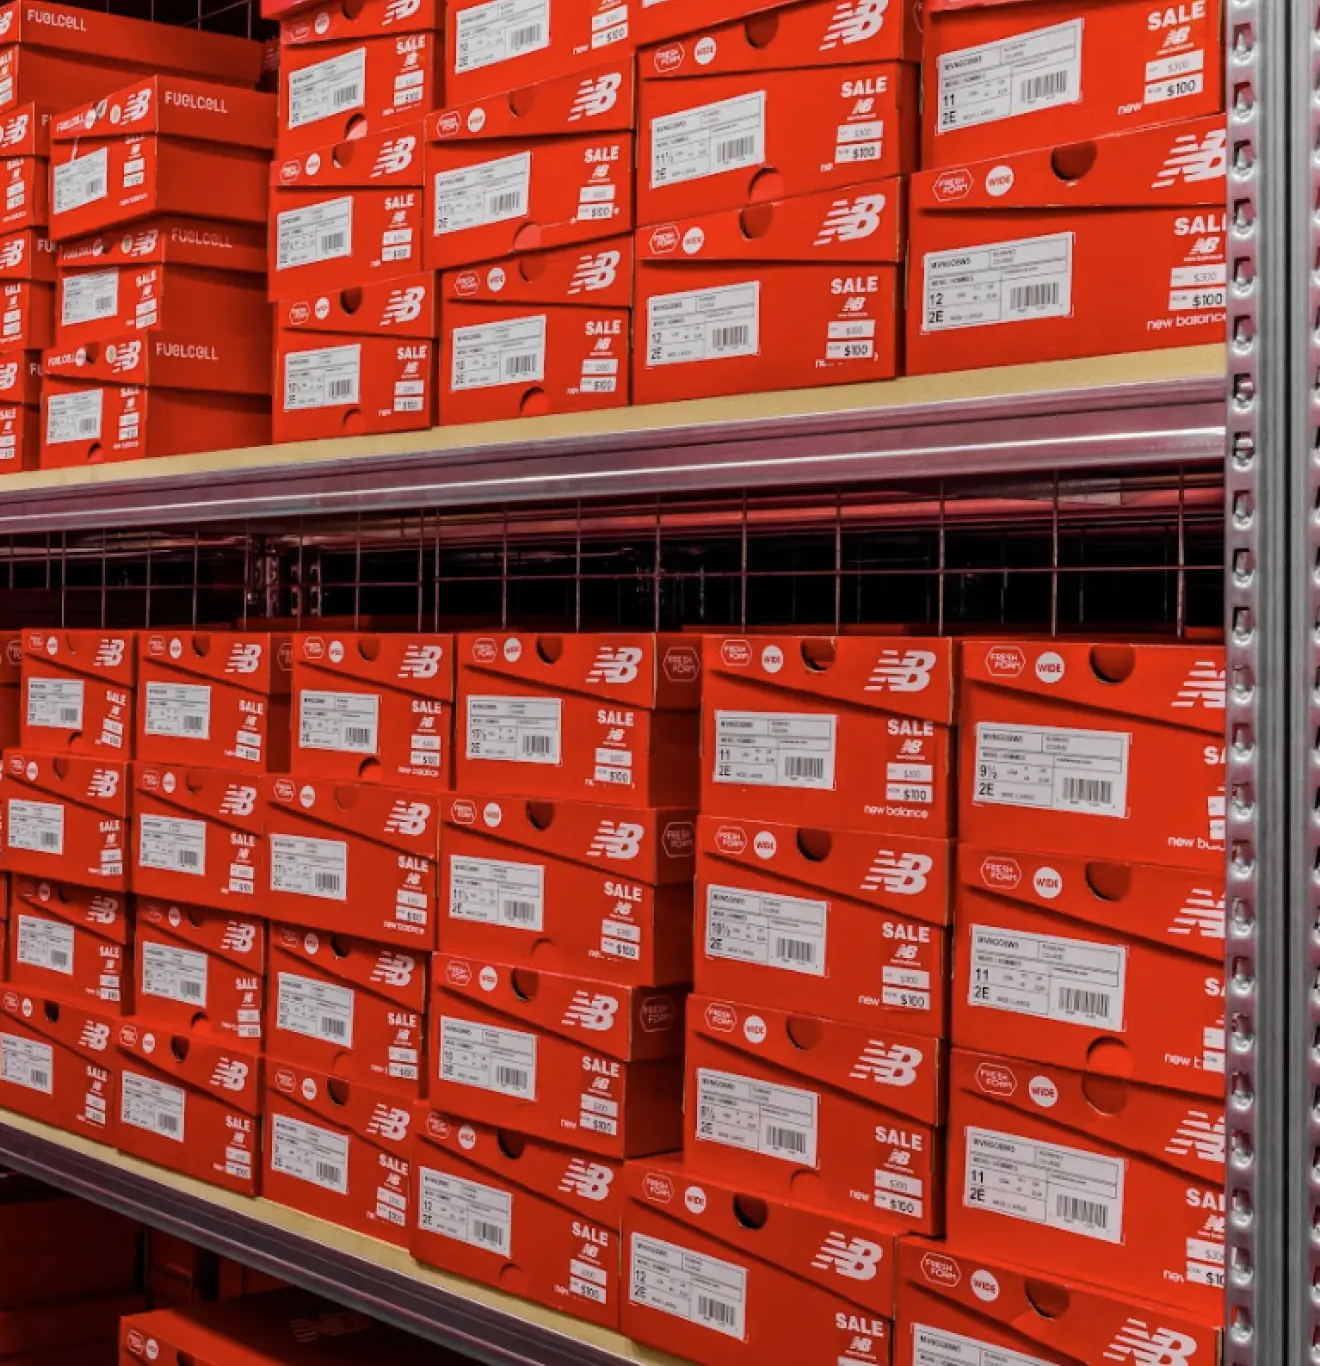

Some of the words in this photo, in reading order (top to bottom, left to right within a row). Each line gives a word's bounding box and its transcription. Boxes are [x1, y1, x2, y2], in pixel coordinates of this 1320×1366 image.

[1147, 1, 1205, 30] SALE
[396, 34, 426, 56] SALE
[841, 76, 888, 98] SALE
[1166, 79, 1197, 97] $100
[568, 72, 621, 120] NB
[942, 92, 956, 107] 11
[942, 110, 957, 125] 2E
[1117, 103, 1142, 116] new
[371, 137, 416, 177] NB
[584, 145, 620, 163] SALE
[851, 146, 877, 161] $100
[987, 174, 1012, 187] WIDE
[385, 193, 414, 211] SALE
[814, 194, 885, 245] NB
[568, 251, 620, 294] NB
[831, 275, 878, 295] SALE
[380, 287, 425, 325] NB
[929, 292, 944, 306] 12
[1192, 293, 1223, 308] $100
[928, 310, 944, 324] 2E
[1147, 318, 1172, 331] new
[585, 319, 622, 336] SALE
[397, 344, 427, 361] SALE
[843, 344, 869, 358] $100
[93, 639, 124, 666] NB
[225, 643, 261, 672] NB
[990, 652, 1018, 661] FRESH
[398, 646, 442, 678] NB
[585, 647, 642, 683] NB
[864, 650, 936, 691] NB
[1036, 662, 1062, 674] WIDE
[239, 699, 264, 716] SALE
[412, 700, 442, 715] SALE
[597, 708, 635, 727] SALE
[888, 719, 934, 737] SALE
[903, 788, 927, 802] $100
[978, 781, 995, 798] 2E
[219, 785, 256, 815] NB
[384, 801, 430, 836] NB
[864, 805, 885, 816] new
[887, 805, 929, 819] balance
[231, 832, 256, 847] SALE
[587, 820, 644, 859] NB
[1167, 836, 1195, 849] new
[398, 854, 429, 874] SALE
[860, 850, 933, 894] NB
[985, 863, 1013, 874] FRESH
[1035, 874, 1060, 890] WIDE
[604, 880, 643, 902] SALE
[220, 922, 255, 953] NB
[882, 921, 931, 943] SALE
[615, 942, 636, 958] $100
[370, 953, 414, 986] NB
[975, 967, 989, 982] 11
[236, 977, 259, 991] SALE
[974, 985, 990, 1000] 2E
[858, 995, 880, 1007] new
[900, 992, 926, 1007] $100
[561, 991, 618, 1030] NB
[388, 1011, 417, 1028] SALE
[582, 1054, 620, 1078] SALE
[850, 1040, 923, 1086] NB
[1164, 1052, 1191, 1066] new
[210, 1058, 248, 1091] NB
[1031, 1086, 1056, 1098] WIDE
[226, 1114, 251, 1133] SALE
[367, 1104, 410, 1140] NB
[593, 1118, 612, 1133] $100
[875, 1125, 924, 1152] SALE
[379, 1153, 409, 1175] SALE
[558, 1158, 613, 1201] NB
[971, 1169, 984, 1184] 11
[848, 1189, 870, 1202] new
[970, 1186, 985, 1203] 2E
[888, 1199, 915, 1214] $100
[572, 1220, 609, 1248] SALE
[811, 1232, 883, 1280] NB
[925, 1259, 953, 1273] FRESH
[930, 1269, 957, 1281] FOAM
[973, 1278, 997, 1295] WIDE
[835, 1311, 885, 1338] SALE
